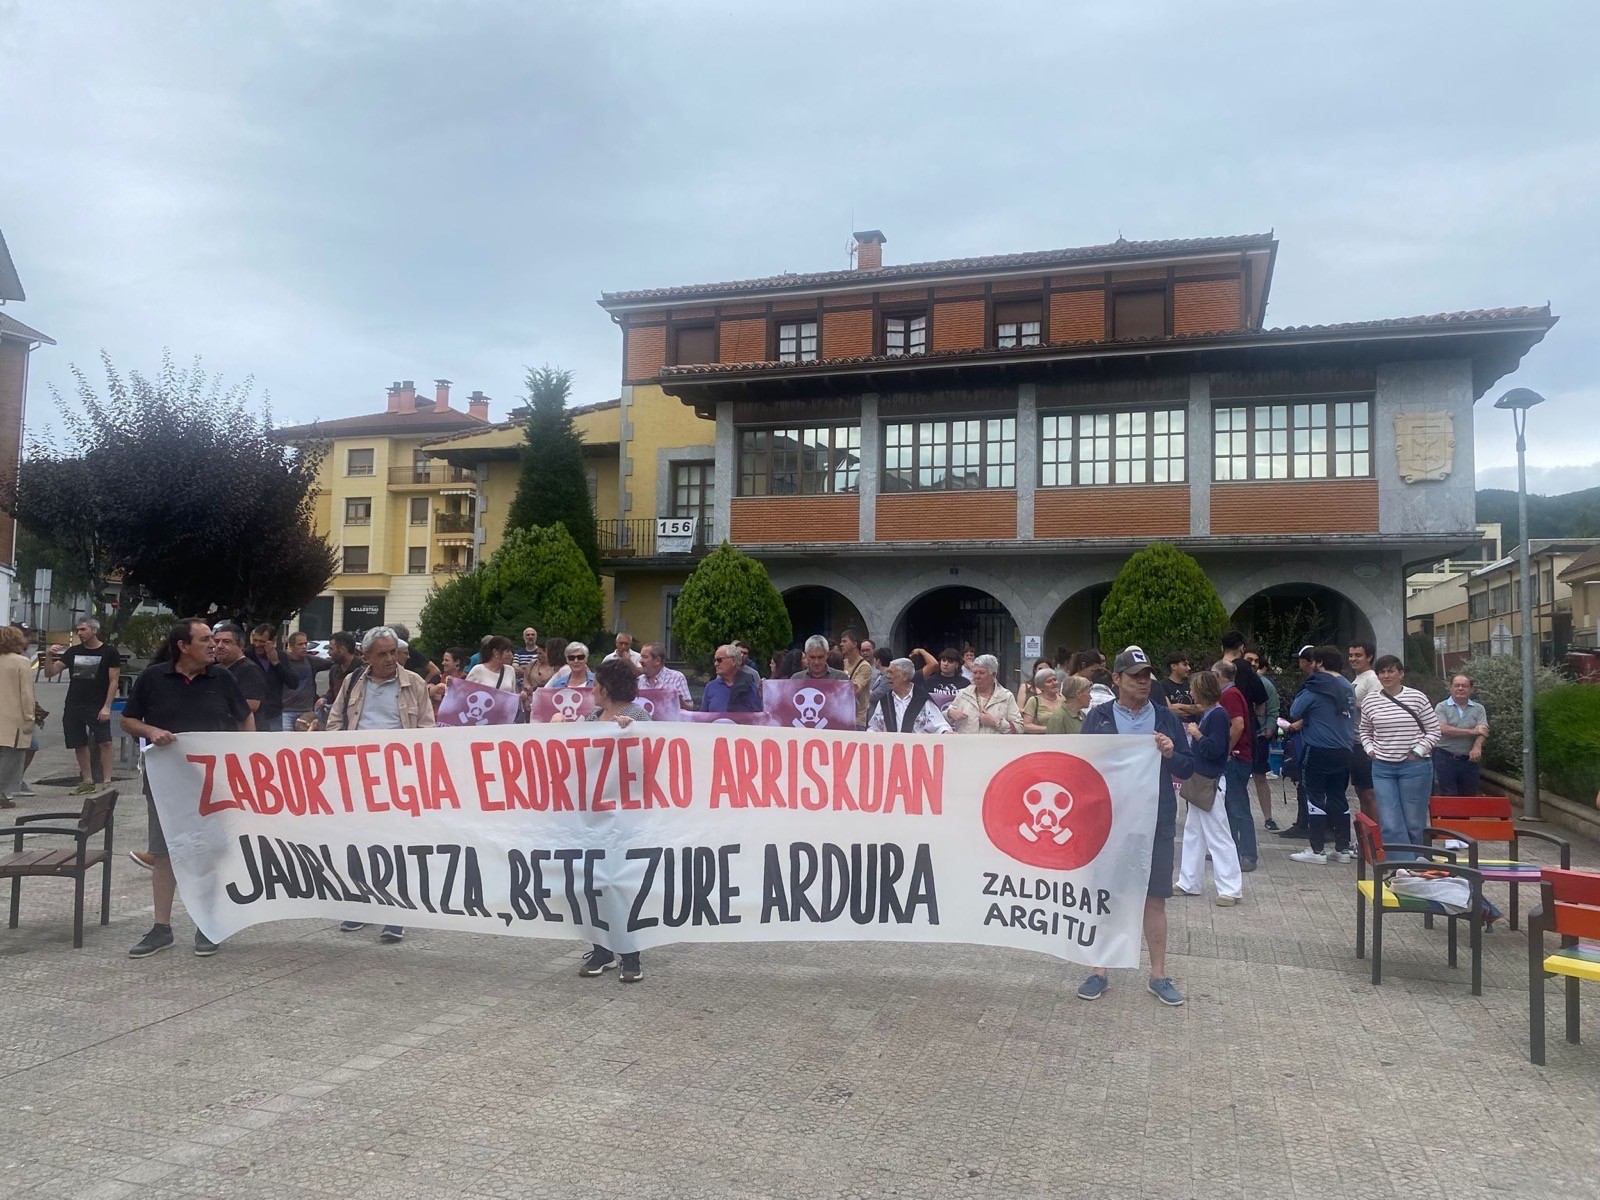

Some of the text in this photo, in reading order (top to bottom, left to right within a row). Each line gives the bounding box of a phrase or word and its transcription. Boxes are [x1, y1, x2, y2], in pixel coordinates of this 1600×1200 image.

[660, 521, 691, 533] 156
[186, 737, 944, 817] ZABORTEGIA ERORTZEKO ARRISKUAN
[508, 849, 609, 932] BETE
[625, 844, 742, 932] ZURE
[760, 841, 940, 925] ARDURA
[982, 872, 1111, 915] ZALDIBAR
[983, 903, 1097, 947] ARGITU
